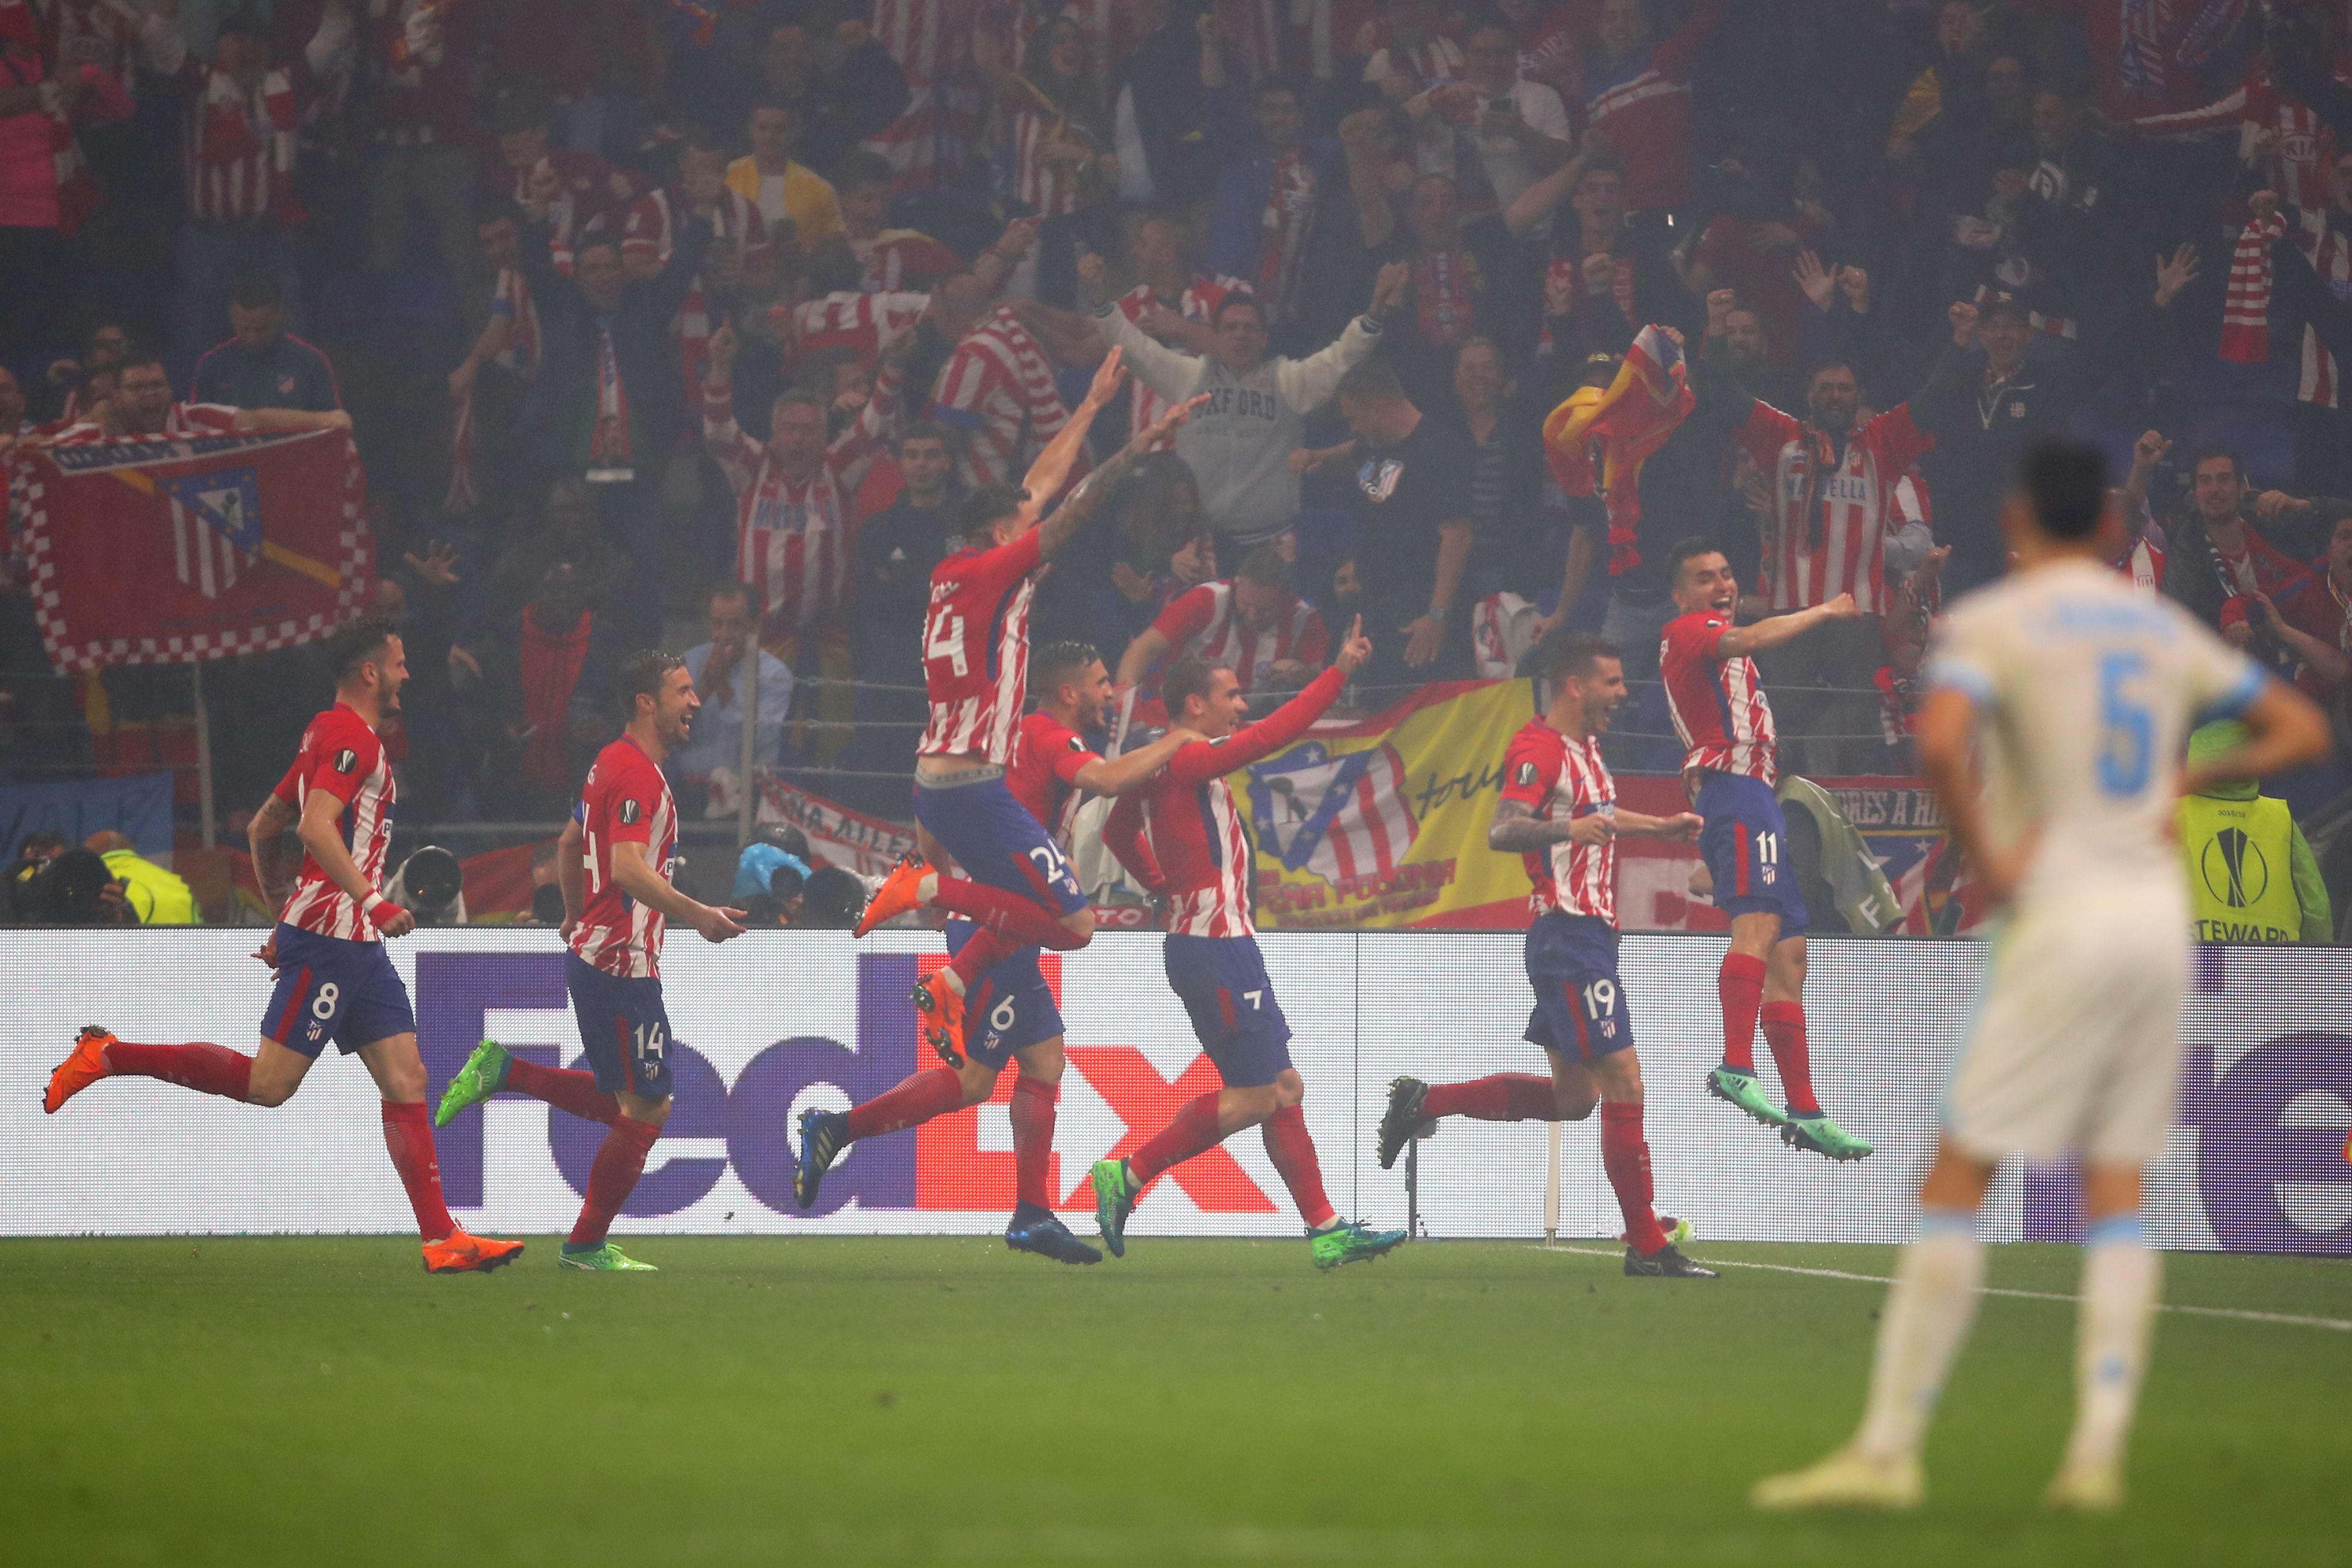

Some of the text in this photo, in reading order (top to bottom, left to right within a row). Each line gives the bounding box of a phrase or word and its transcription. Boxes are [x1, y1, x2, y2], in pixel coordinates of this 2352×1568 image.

[2099, 652, 2157, 801] 5
[1756, 830, 1777, 864] 11
[312, 982, 338, 1019] 8
[991, 994, 1015, 1030] 6
[1243, 990, 1262, 1010] 7
[1583, 978, 1616, 1019] 19
[634, 1021, 664, 1059] 14
[415, 953, 1279, 1219] FedEx
